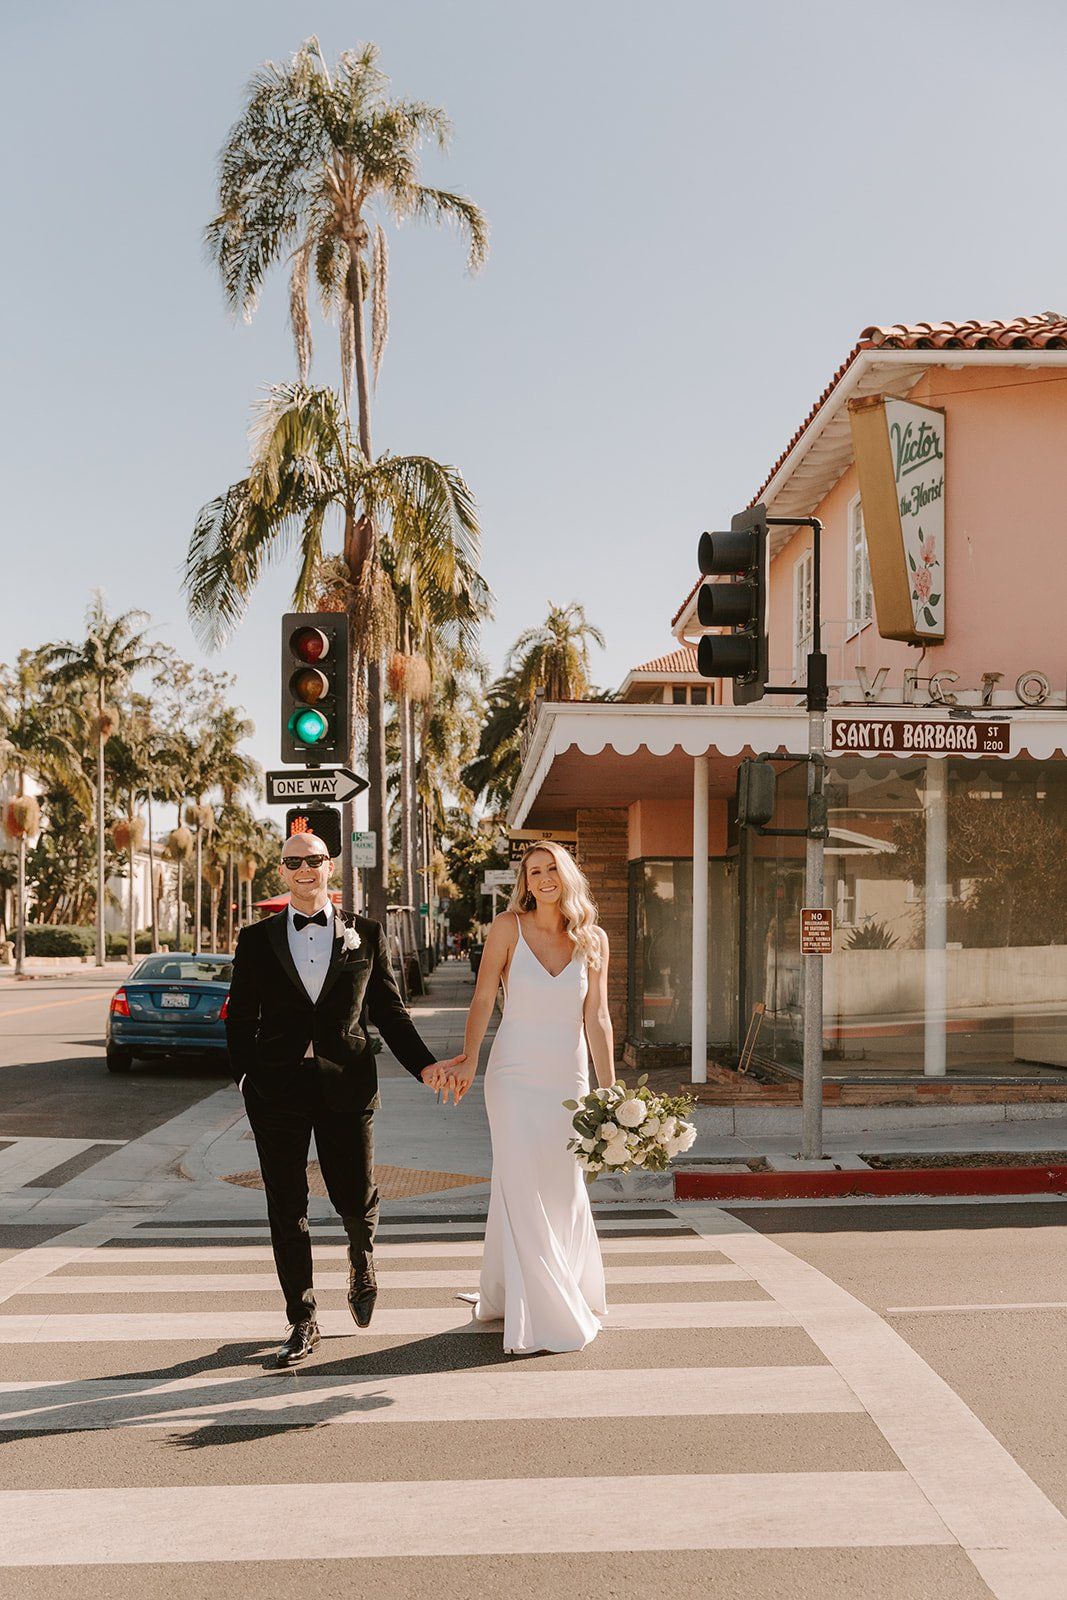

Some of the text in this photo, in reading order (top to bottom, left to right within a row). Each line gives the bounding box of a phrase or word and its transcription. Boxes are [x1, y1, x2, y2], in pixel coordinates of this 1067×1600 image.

[891, 422, 943, 483] Victor
[900, 476, 944, 517] the Florist
[855, 666, 1067, 708] VICTO
[835, 723, 978, 750] SANTA BARBARA
[987, 727, 999, 737] ST
[983, 741, 1004, 751] 1200
[277, 779, 338, 794] ONE WAY
